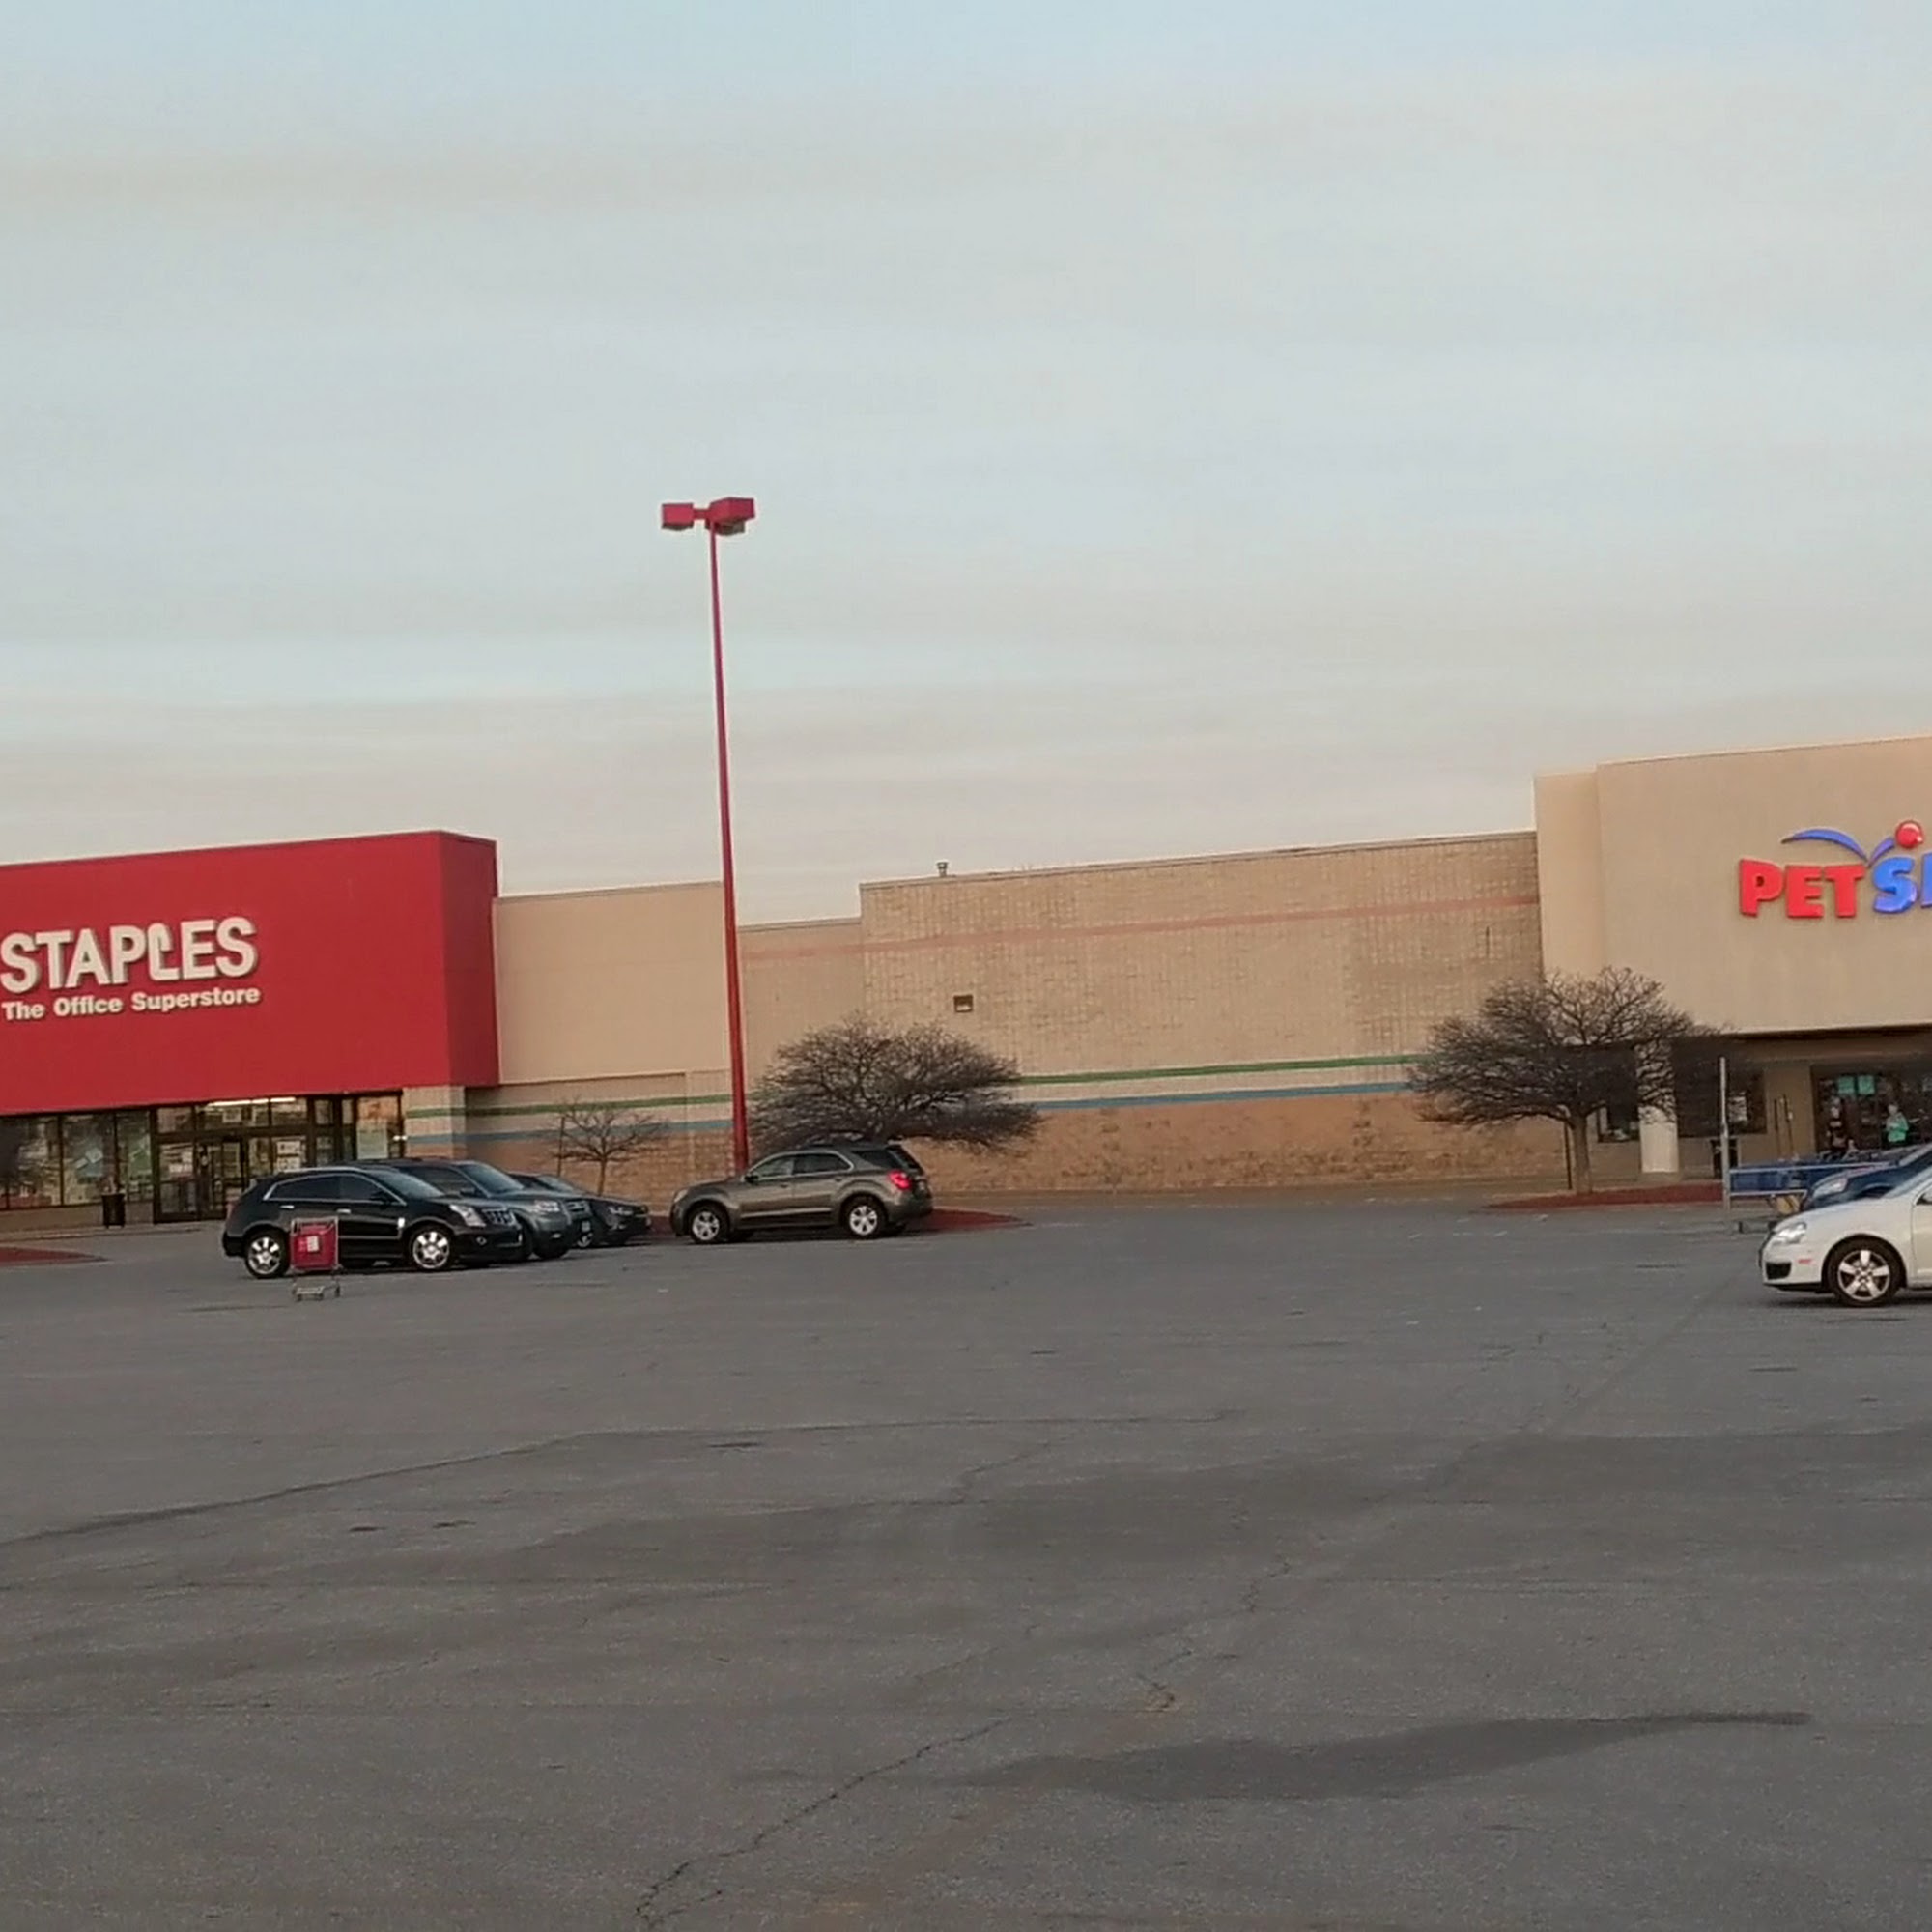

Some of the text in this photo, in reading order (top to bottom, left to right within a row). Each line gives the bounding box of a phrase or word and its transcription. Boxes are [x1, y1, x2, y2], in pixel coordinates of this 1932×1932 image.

[1739, 852, 1932, 919] PETS
[0, 917, 256, 993] STAPLES
[2, 987, 260, 1020] The Office Superstore
